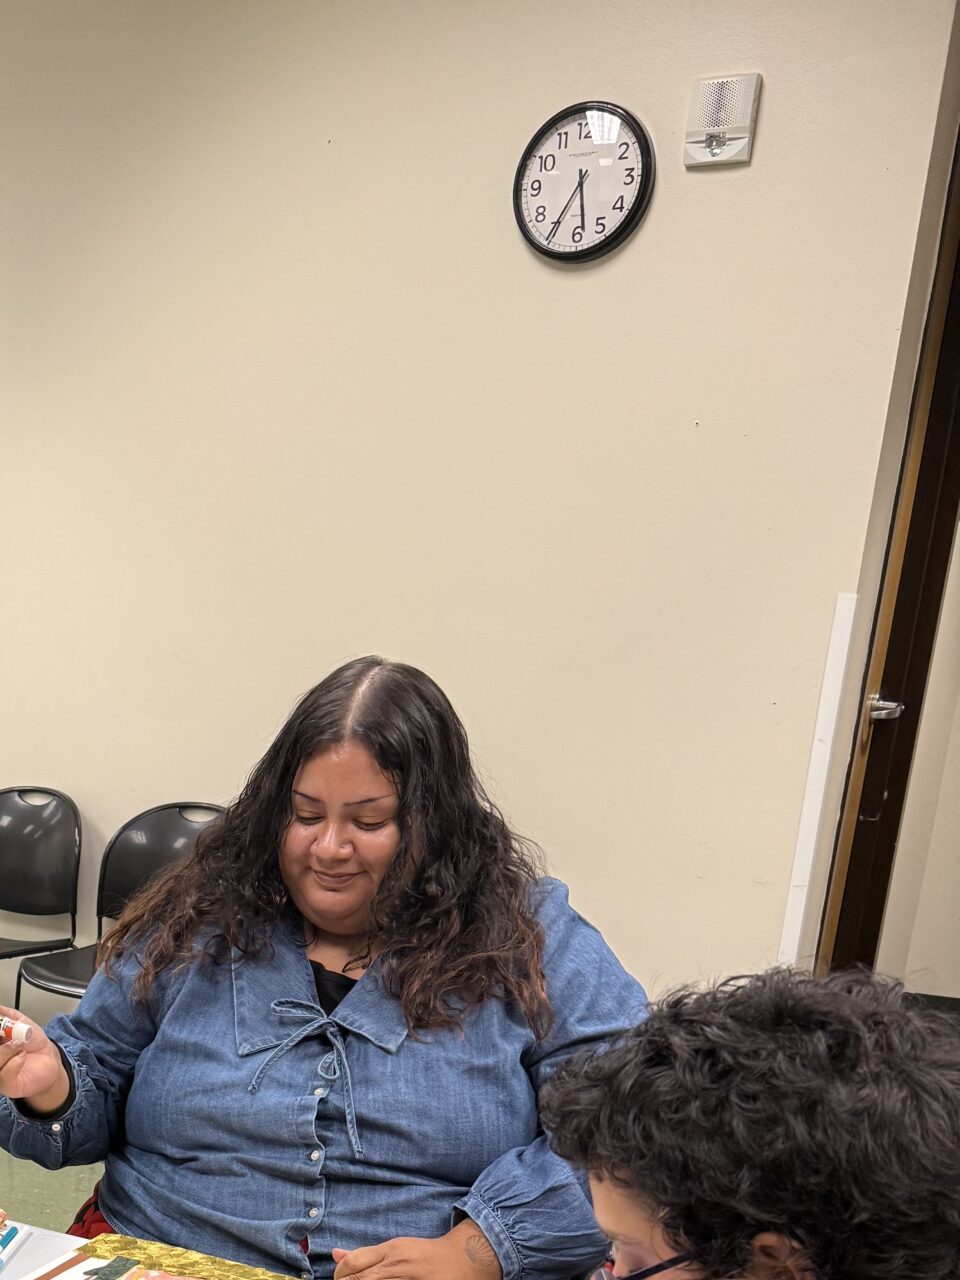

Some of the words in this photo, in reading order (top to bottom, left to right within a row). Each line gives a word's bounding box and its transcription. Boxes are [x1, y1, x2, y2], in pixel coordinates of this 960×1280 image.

[556, 131, 569, 150] 11
[617, 141, 630, 160] 2
[538, 154, 556, 172] 10
[623, 167, 636, 186] 3
[530, 179, 542, 197] 9
[611, 195, 625, 212] 4
[534, 205, 546, 223] 8
[571, 225, 583, 243] 6
[594, 216, 607, 234] 5
